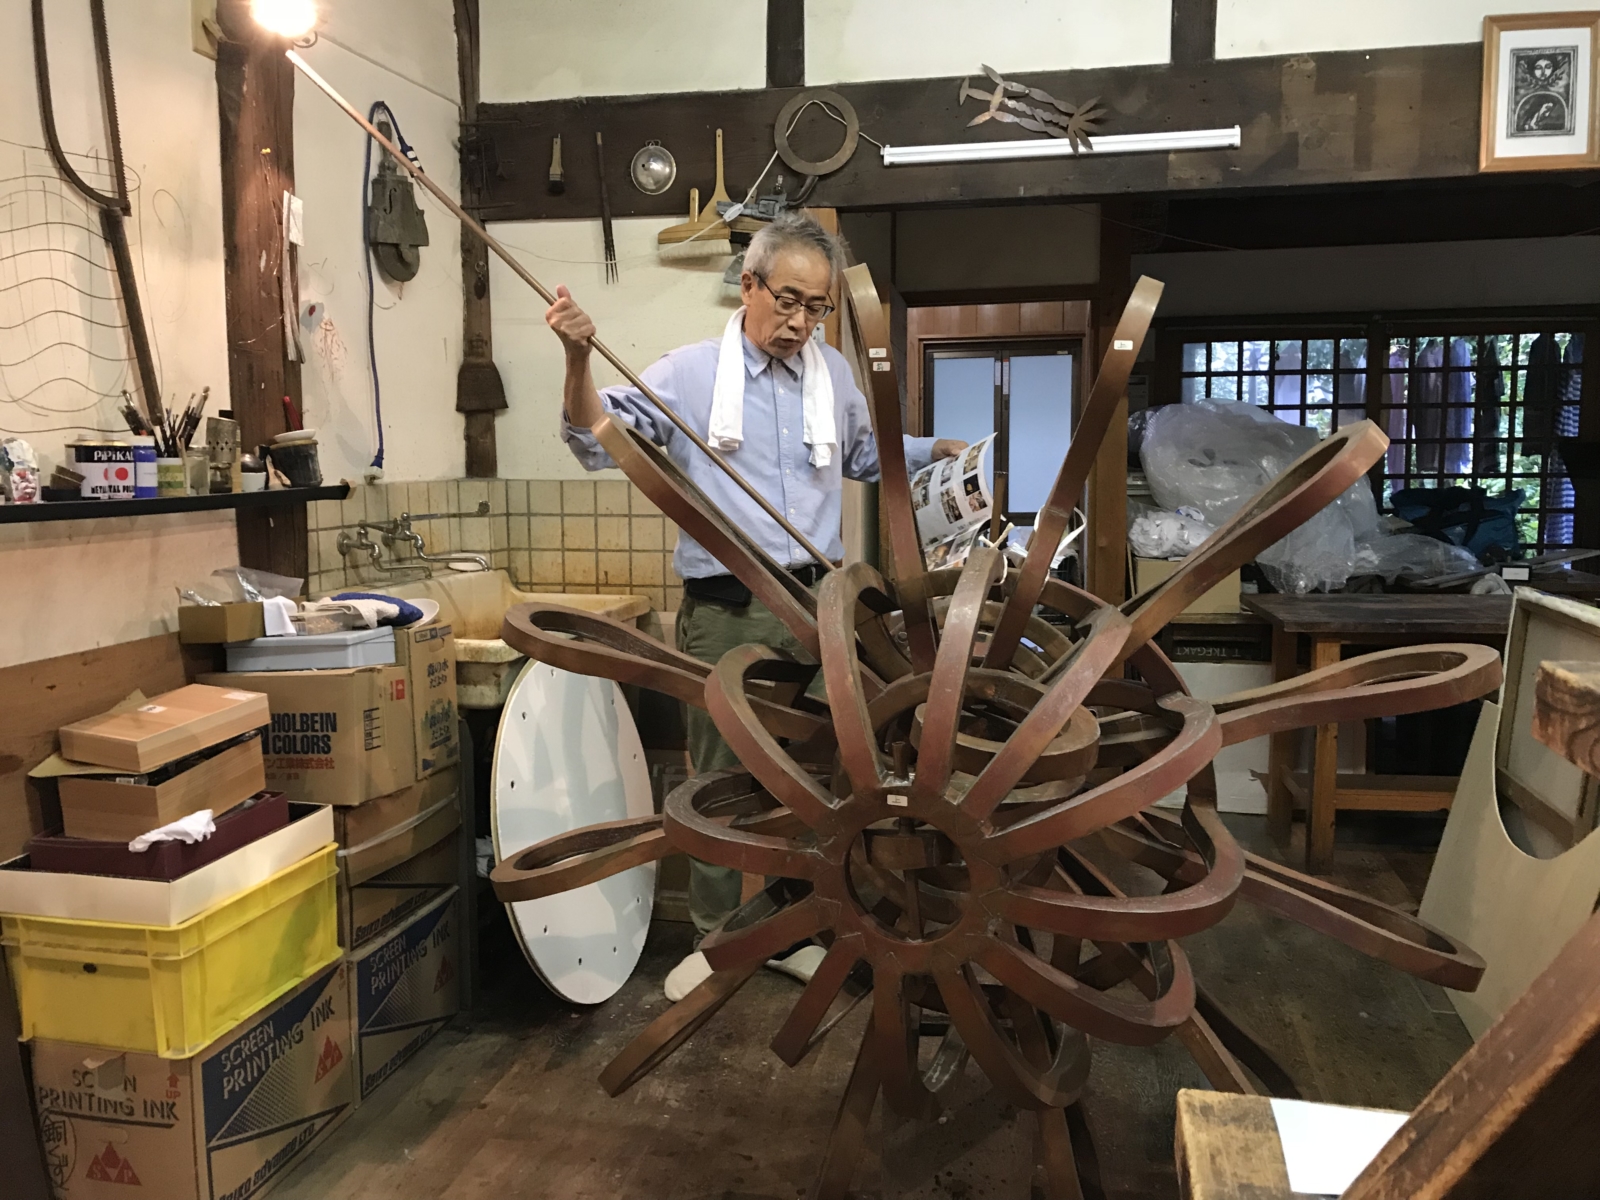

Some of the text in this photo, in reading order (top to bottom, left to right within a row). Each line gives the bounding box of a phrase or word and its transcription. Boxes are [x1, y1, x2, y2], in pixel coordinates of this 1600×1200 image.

[271, 712, 338, 733] HOLBEIN
[271, 734, 332, 755] COLORS
[370, 934, 407, 973] SCREEN
[371, 938, 428, 996] PRINTING
[432, 920, 451, 949] INK
[220, 1020, 275, 1073] SCREEN
[223, 995, 336, 1100] PRINTING INK
[38, 1086, 180, 1121] PRINTING INK
[165, 1090, 181, 1100] UP
